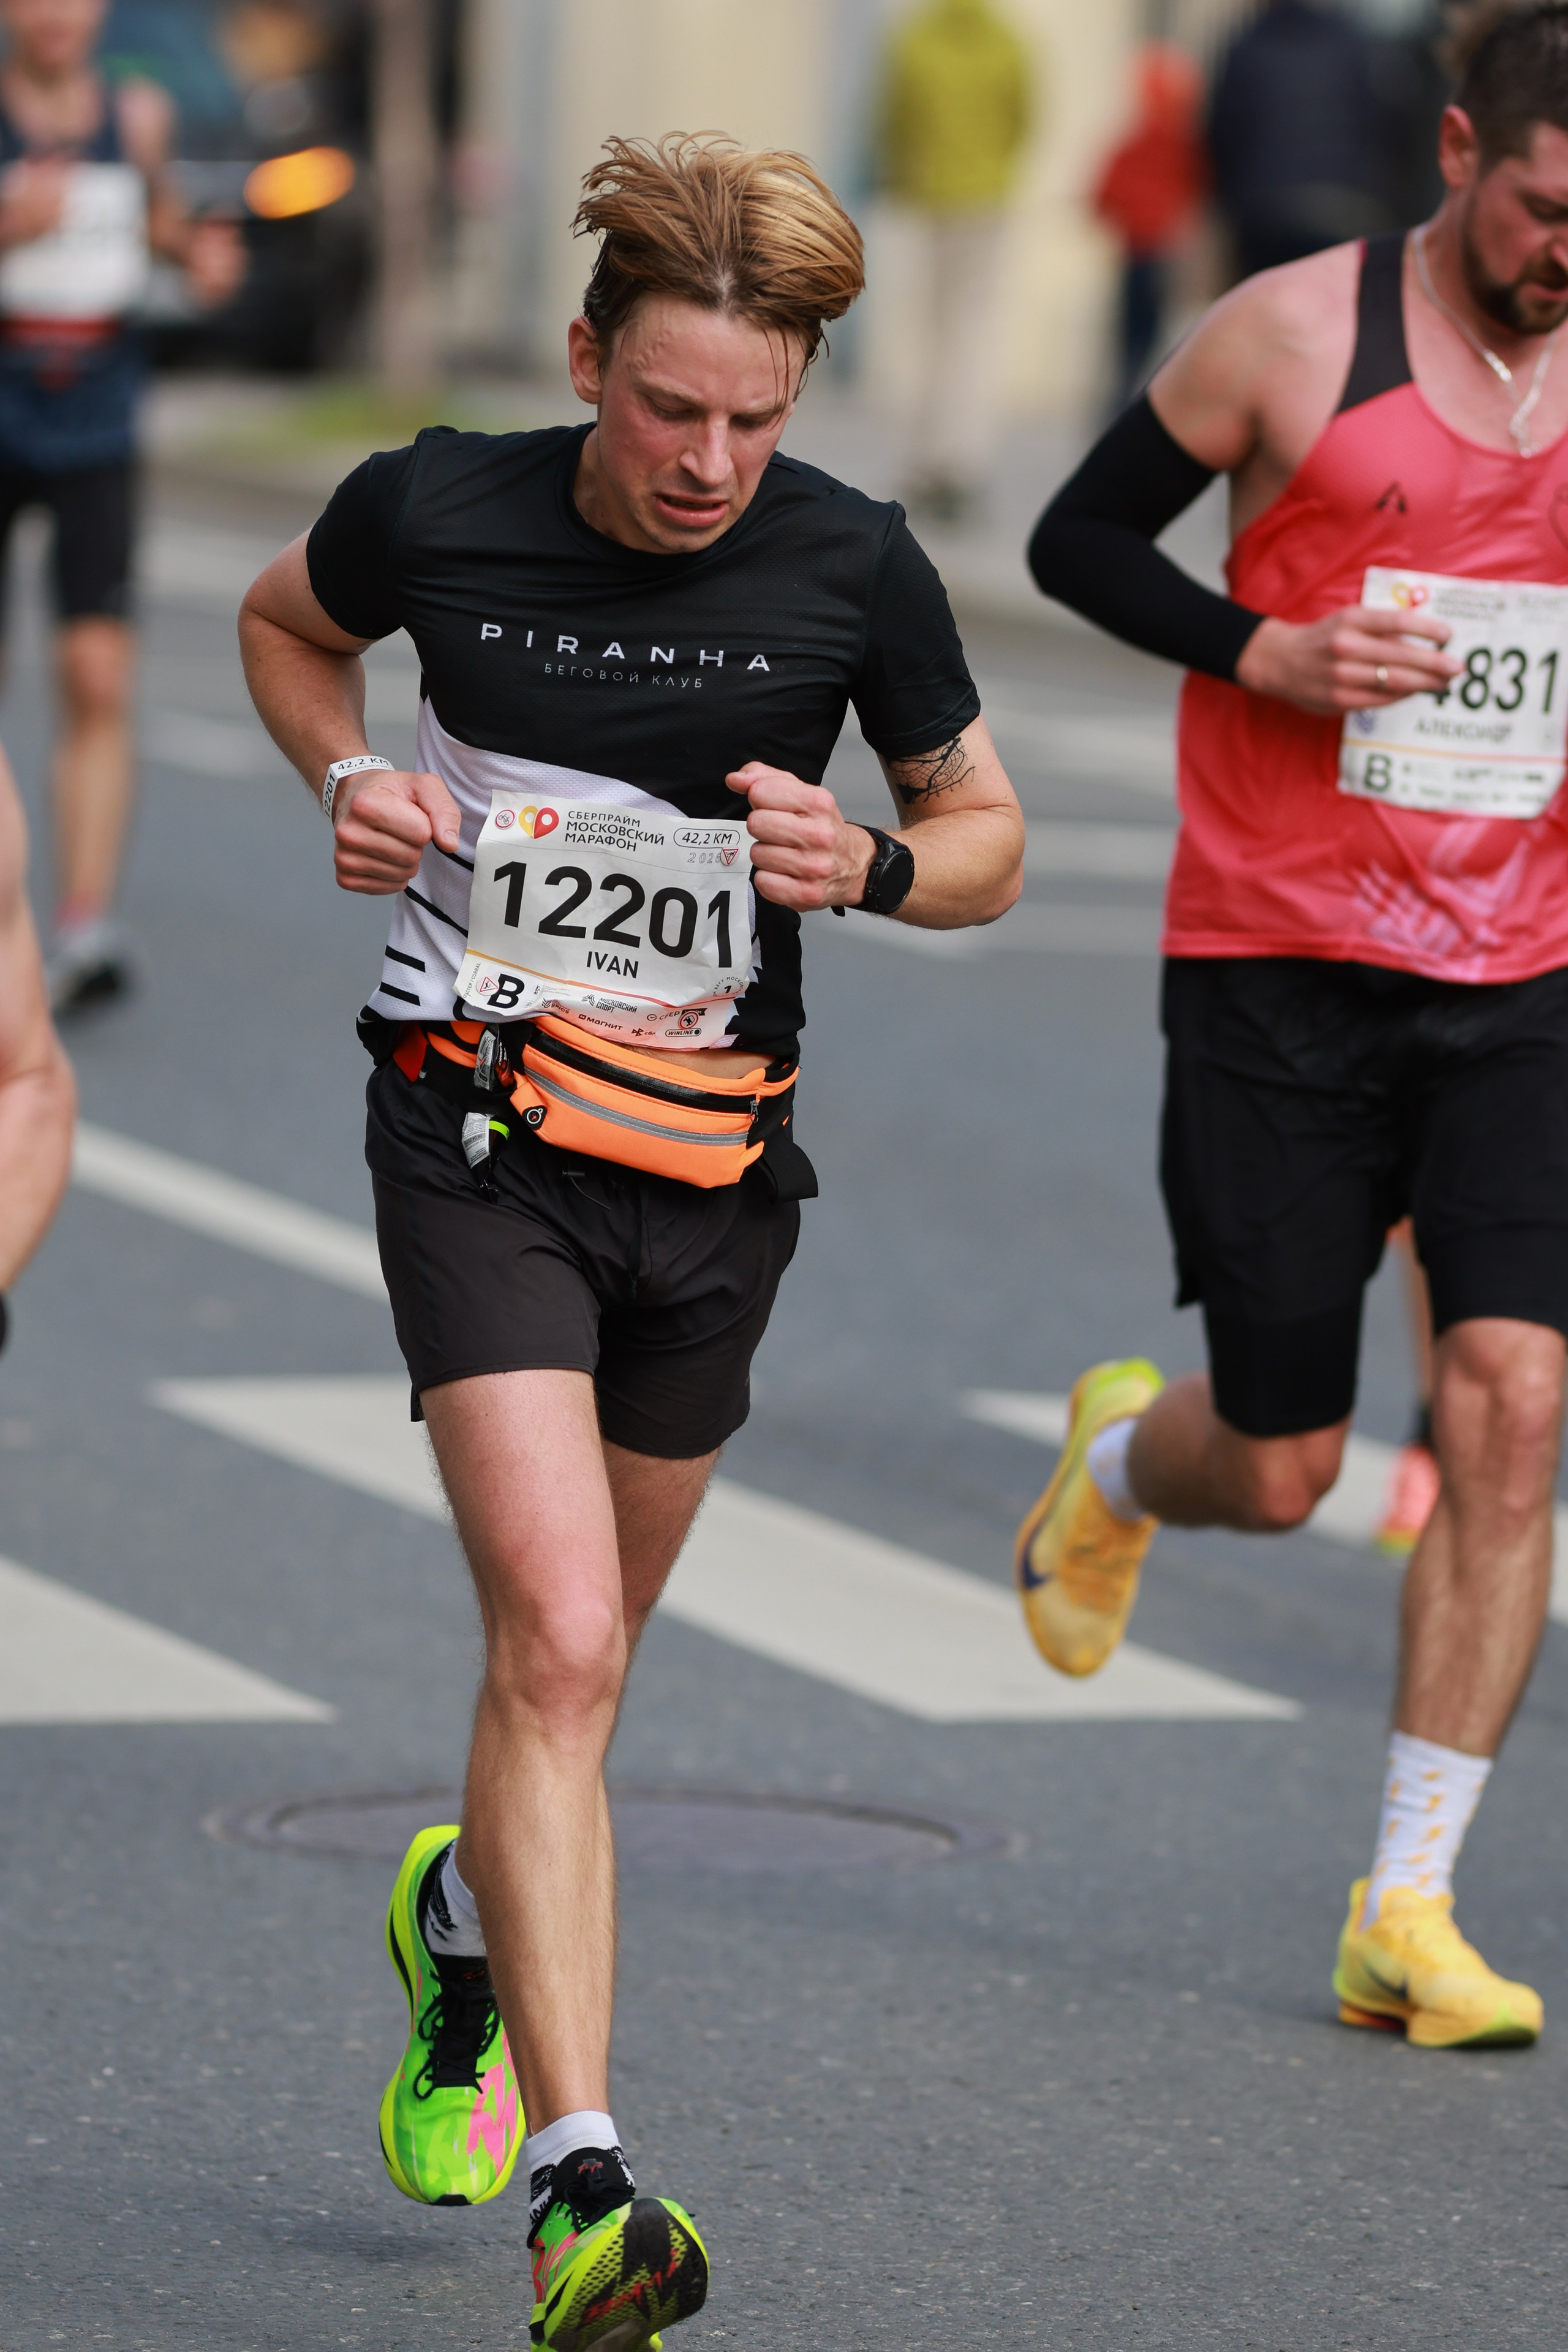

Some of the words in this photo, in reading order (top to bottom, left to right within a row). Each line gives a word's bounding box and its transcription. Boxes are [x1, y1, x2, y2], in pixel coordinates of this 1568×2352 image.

[481, 623, 770, 671] PIRANHA
[545, 663, 639, 683] БЕГОВОЙ
[652, 674, 703, 688] КЛУБ
[568, 810, 641, 827] СБЕРПРАЙМ
[567, 821, 665, 845] МОСКОВСКИЙ
[682, 832, 710, 845] 42,2
[565, 833, 637, 852] МАРАФОН
[687, 852, 721, 864] 2026
[493, 861, 733, 968] 12201
[472, 962, 481, 979] CORRAL
[586, 951, 639, 979] IVAN
[724, 985, 732, 993] 1
[551, 1003, 570, 1014] BRICS
[596, 1001, 615, 1013] СПОРТ
